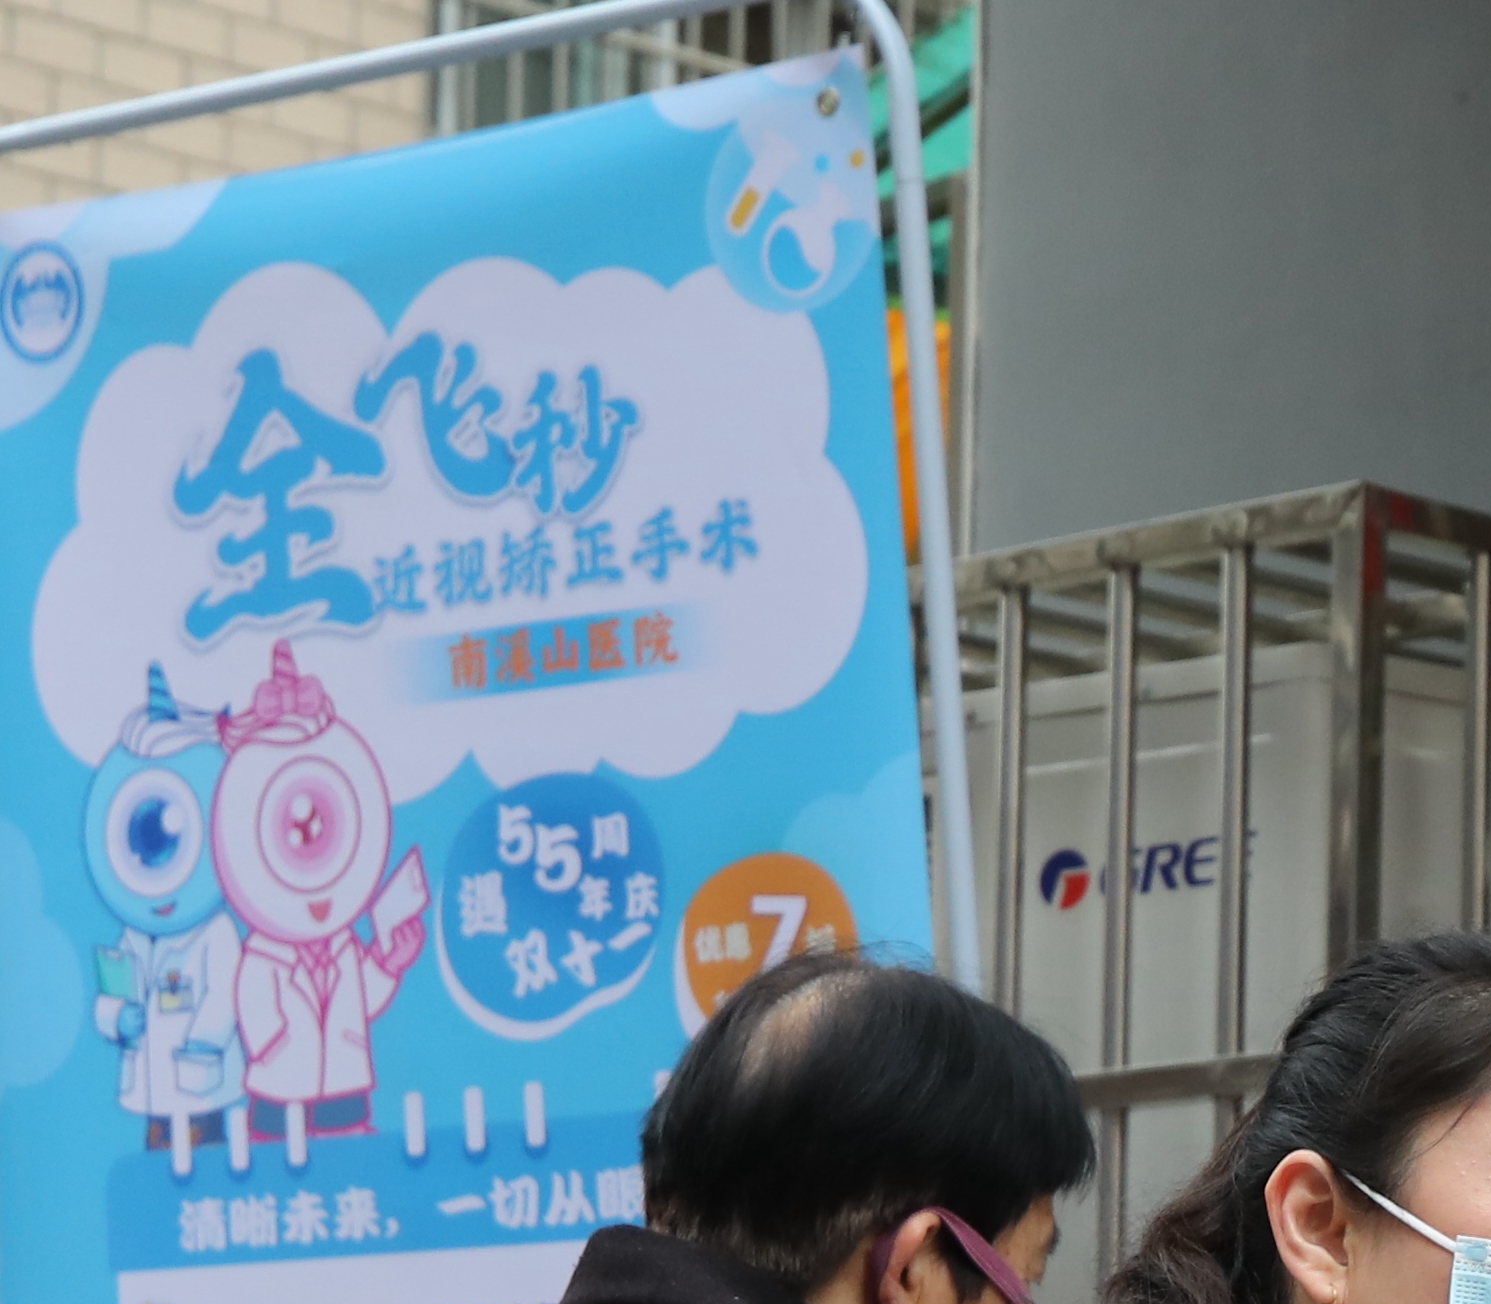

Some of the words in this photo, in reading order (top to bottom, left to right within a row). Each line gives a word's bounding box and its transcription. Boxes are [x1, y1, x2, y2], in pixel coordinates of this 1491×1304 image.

[173, 332, 641, 639] 全飞秒
[370, 498, 760, 618] 近视矫正手术
[449, 613, 681, 690] 南溪山医院
